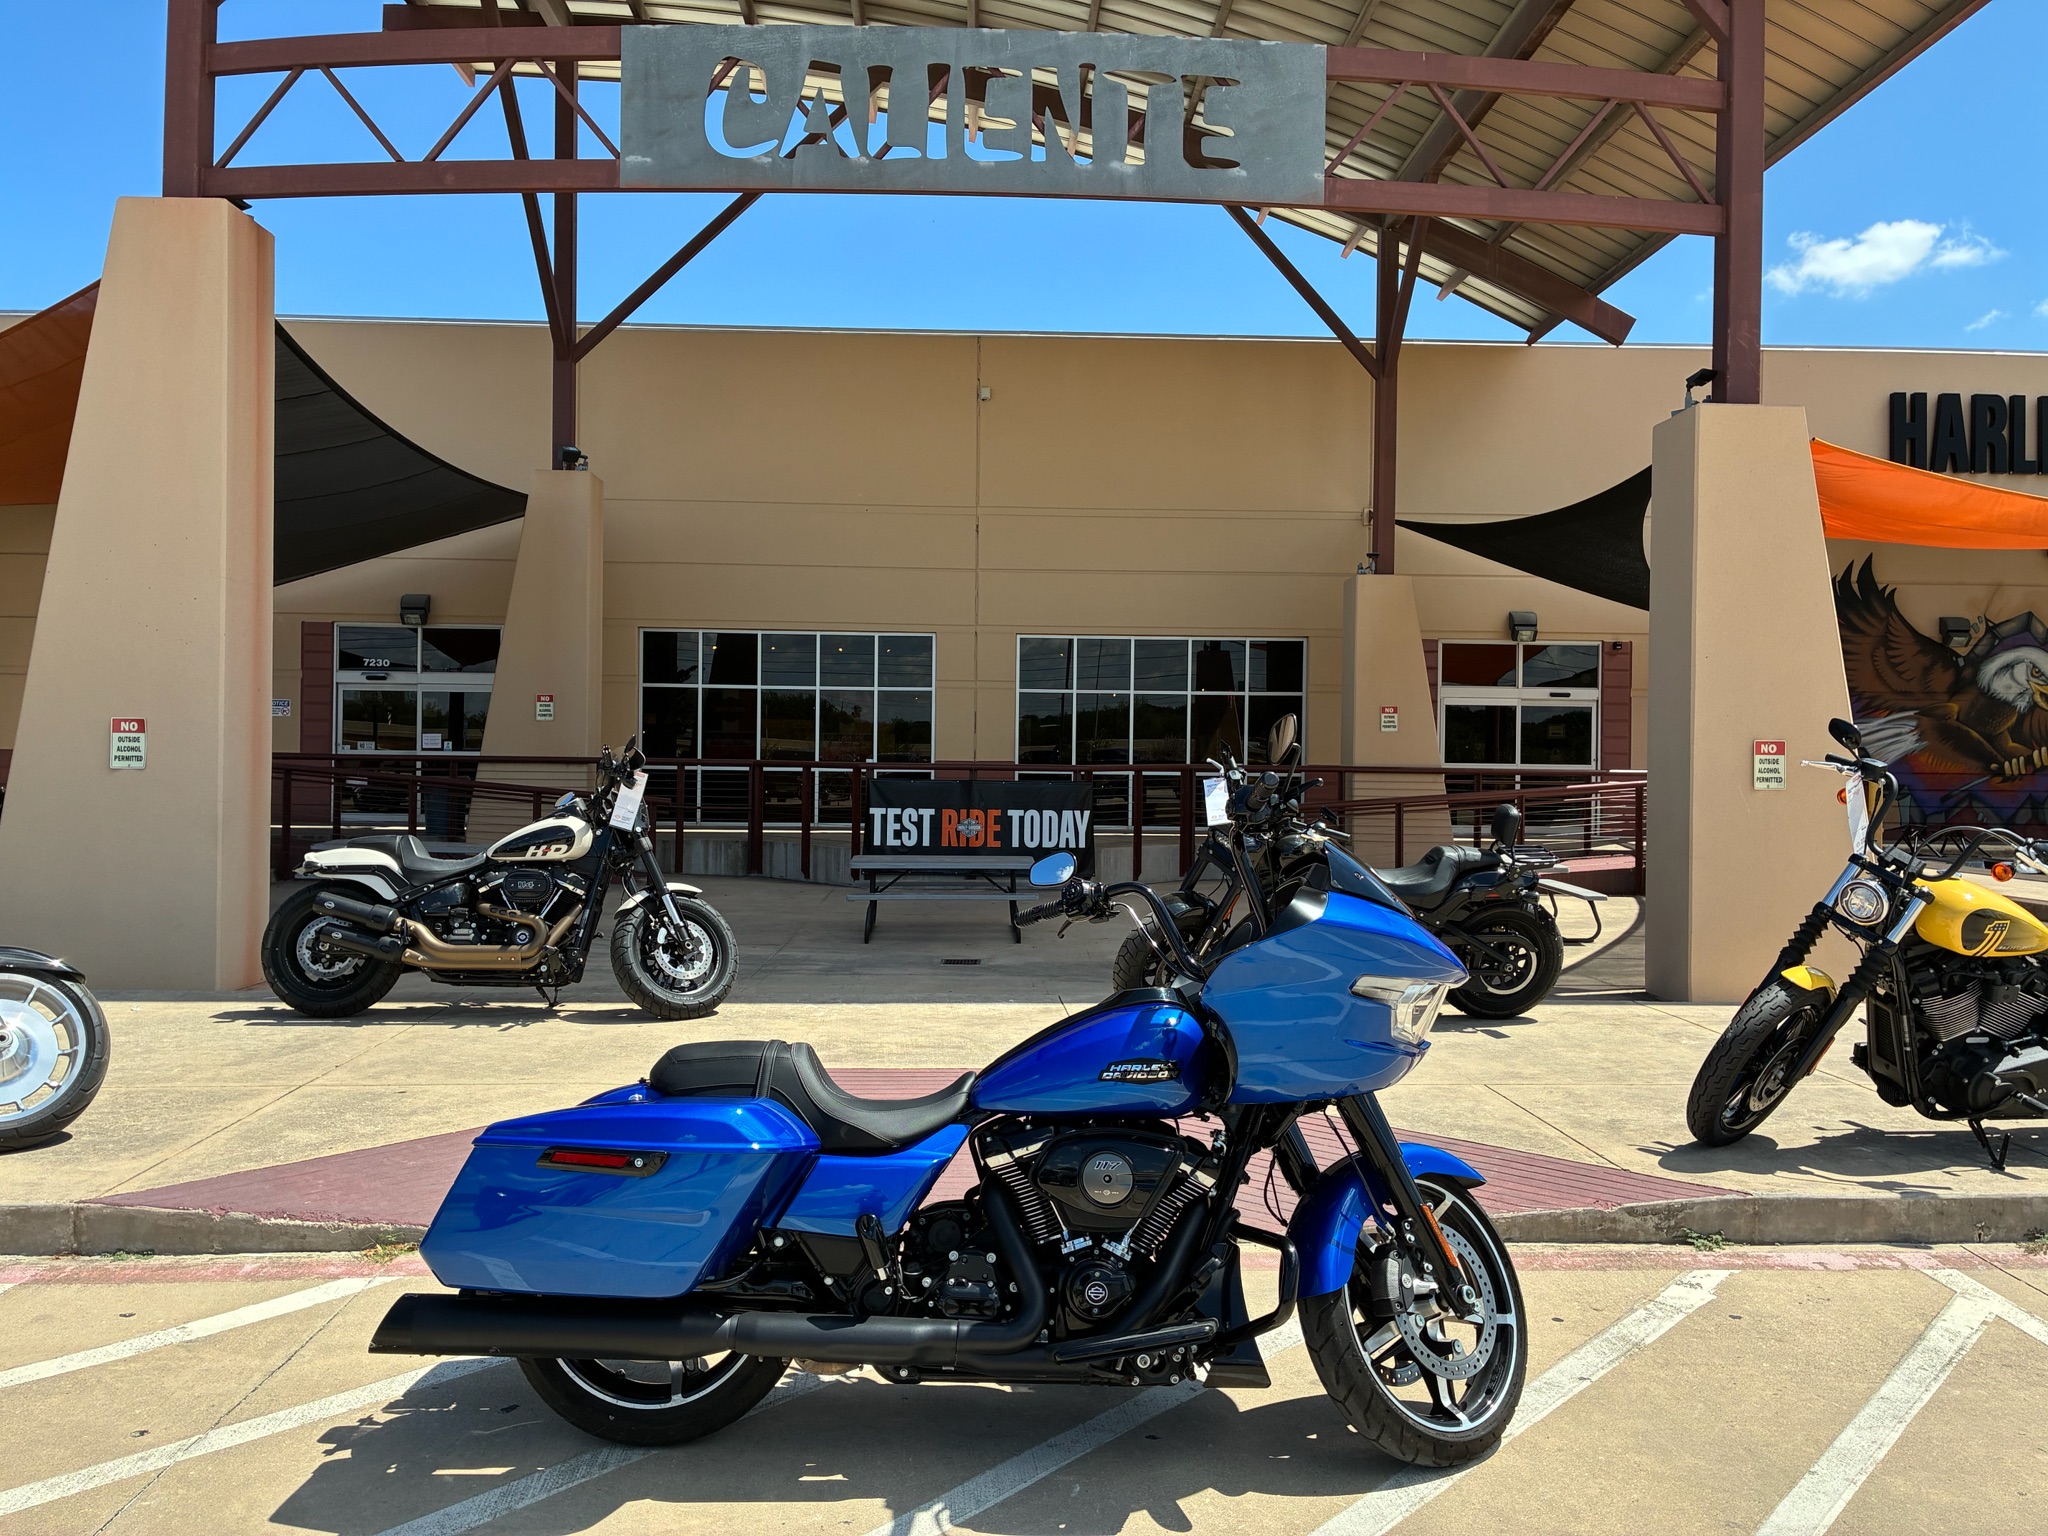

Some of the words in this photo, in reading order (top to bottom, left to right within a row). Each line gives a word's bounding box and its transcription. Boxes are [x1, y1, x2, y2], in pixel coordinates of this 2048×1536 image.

[704, 56, 1242, 170] CALIENTE
[363, 658, 390, 667] 7230
[120, 721, 138, 732] NO
[1760, 743, 1777, 754] NO
[114, 754, 144, 762] PERMITTED
[869, 807, 936, 847] TEST
[941, 808, 1002, 848] RIDE
[1007, 809, 1091, 848] TODAY
[1110, 1063, 1174, 1072] HARLEY
[1094, 1160, 1122, 1170] 117
